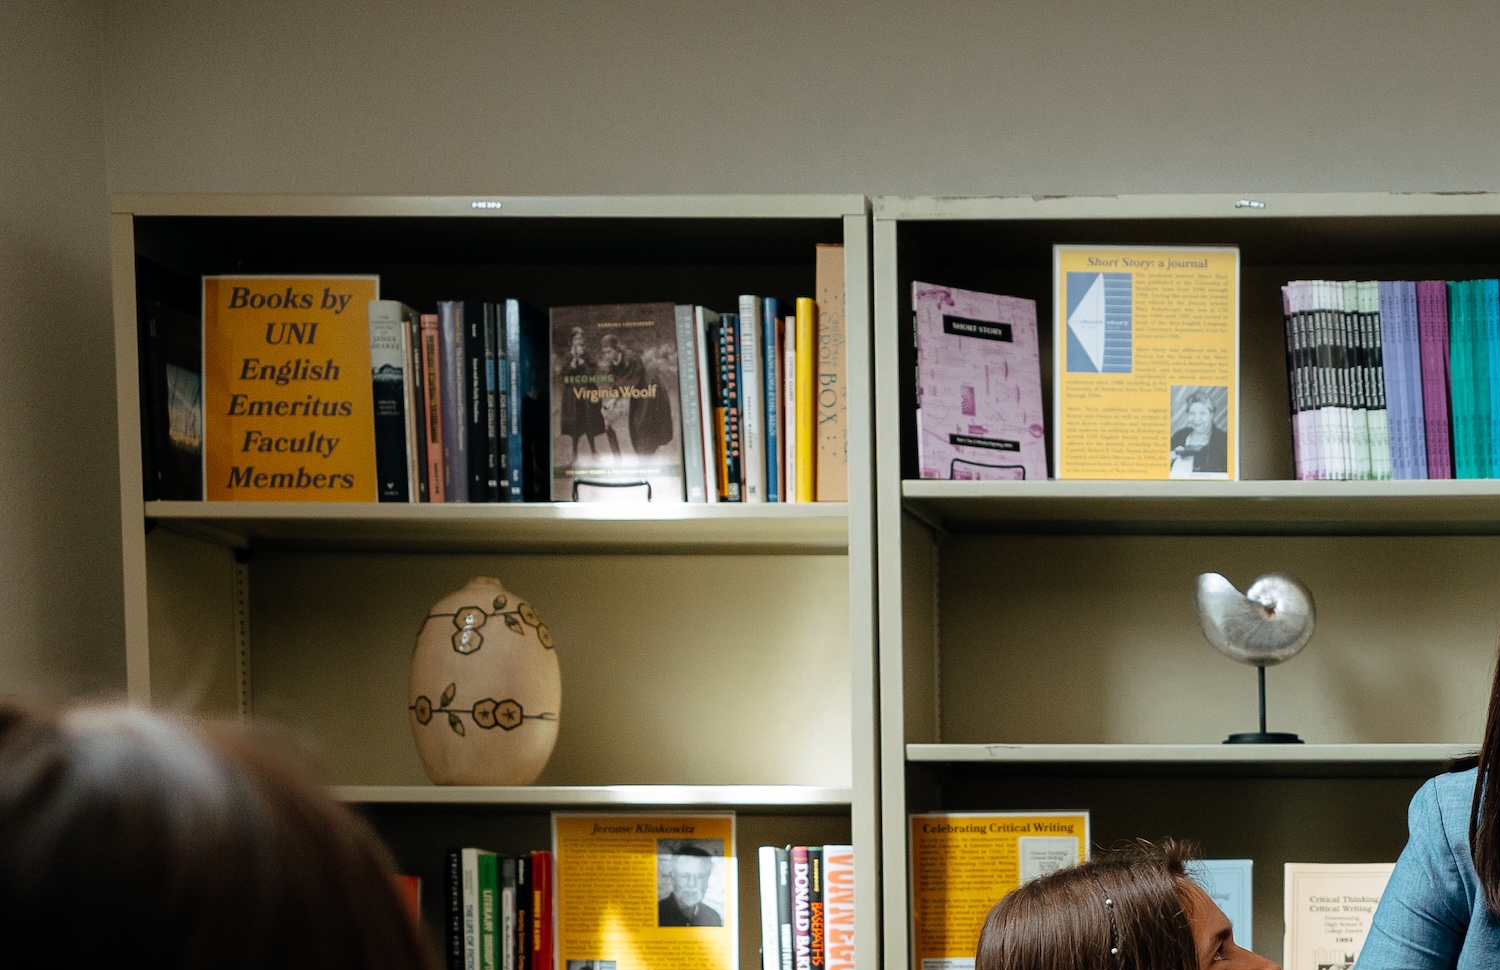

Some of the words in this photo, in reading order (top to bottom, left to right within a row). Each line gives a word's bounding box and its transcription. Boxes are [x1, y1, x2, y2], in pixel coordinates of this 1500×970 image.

[1087, 257, 1118, 267] Short
[1122, 257, 1155, 269] Story:
[1167, 258, 1208, 270] journal
[228, 287, 313, 309] Books
[321, 287, 352, 315] by
[265, 322, 319, 345] UNI
[239, 358, 340, 386] English
[726, 326, 737, 399] TERRIBLE
[228, 394, 353, 417] Emeritus
[573, 386, 619, 404] Virginia
[618, 384, 657, 399] Woolf
[819, 373, 837, 426] BOX
[729, 407, 739, 457] KISSES
[242, 430, 340, 458] Faculty
[227, 466, 354, 489] Members
[591, 823, 632, 836] Jerome
[636, 823, 695, 834] Klinkowitz
[923, 823, 986, 835] Celebrating
[989, 823, 1030, 832] Critical
[1033, 823, 1074, 833] Writing
[450, 853, 459, 912] STRUCTURING
[794, 863, 810, 932] DONALD
[1309, 904, 1340, 912] Critical
[1343, 904, 1372, 913] Writing
[1343, 896, 1380, 904] Thinking
[482, 889, 493, 932] LITERARY
[466, 919, 474, 934] LIFE
[811, 902, 824, 967] BASEPATHS
[452, 935, 460, 955] VOID
